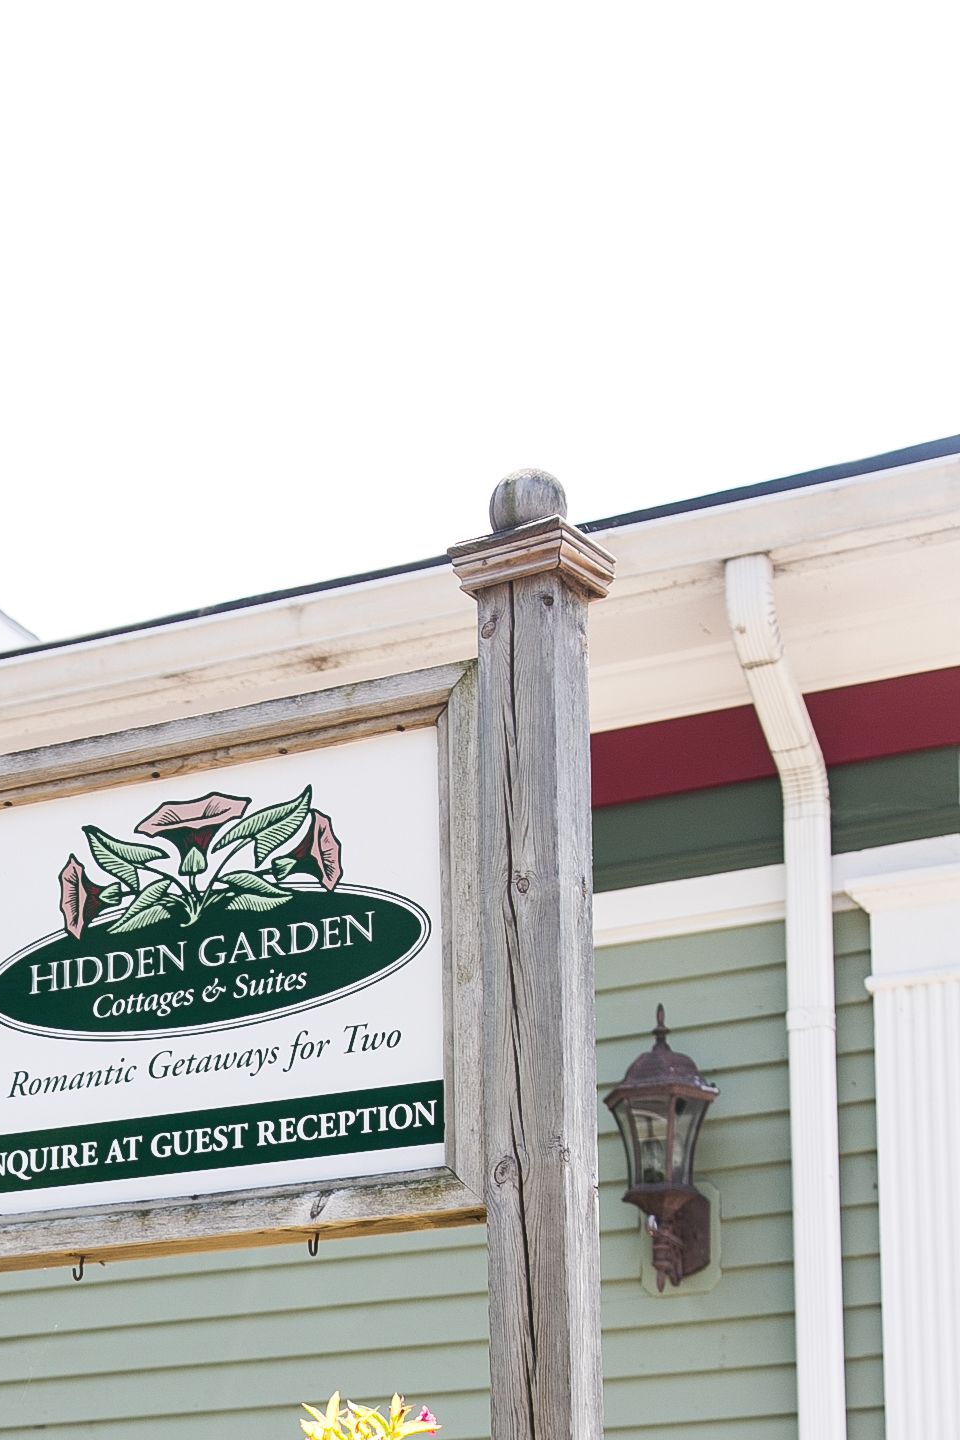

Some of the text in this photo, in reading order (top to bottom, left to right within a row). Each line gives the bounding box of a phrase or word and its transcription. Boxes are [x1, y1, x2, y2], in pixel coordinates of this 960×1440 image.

[29, 911, 375, 995] HIDDEN GARDEN
[92, 970, 307, 1019] Cottages & Suites
[7, 1023, 402, 1098] Romantic Getaways for Two
[105, 1136, 142, 1163] AT
[150, 1124, 248, 1158] GUEST
[256, 1100, 437, 1146] RECEPTION
